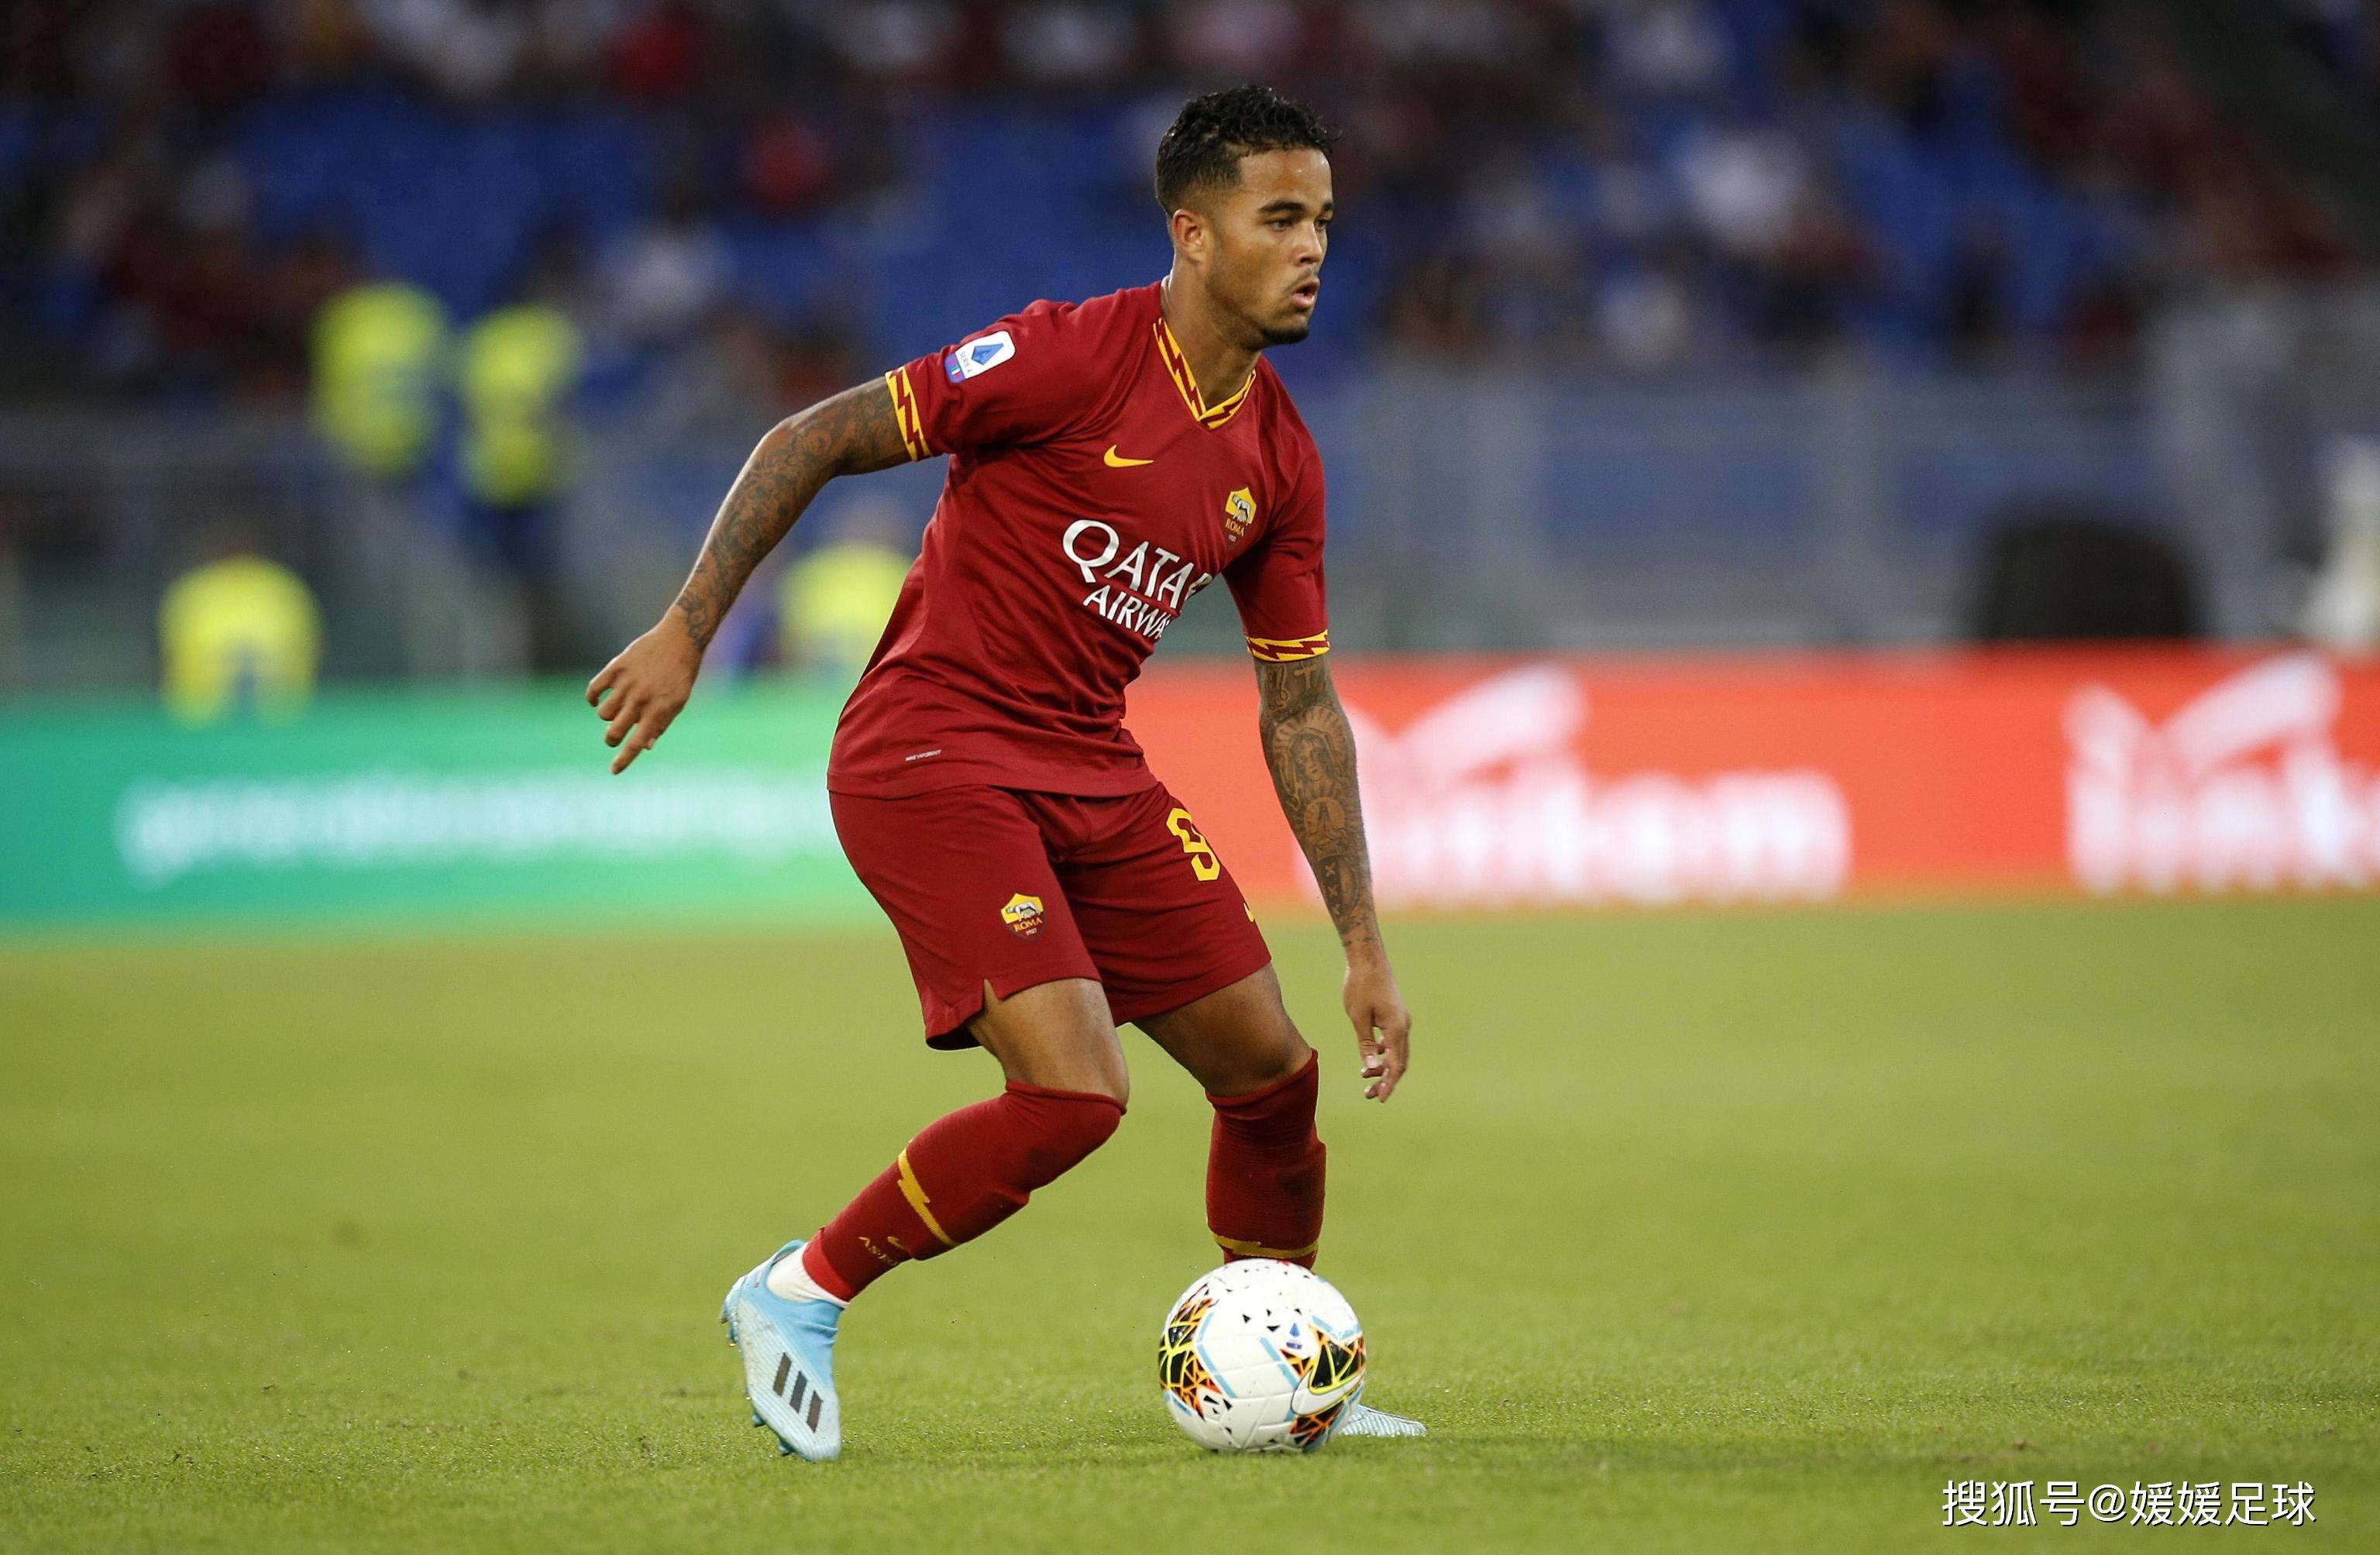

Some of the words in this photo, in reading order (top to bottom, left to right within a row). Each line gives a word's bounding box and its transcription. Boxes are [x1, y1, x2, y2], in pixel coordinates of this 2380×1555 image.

[1225, 518, 1245, 536] ROMA
[1083, 584, 1175, 640] AIRWA
[1166, 807, 1220, 881] 9
[1013, 917, 1043, 932] ROMA
